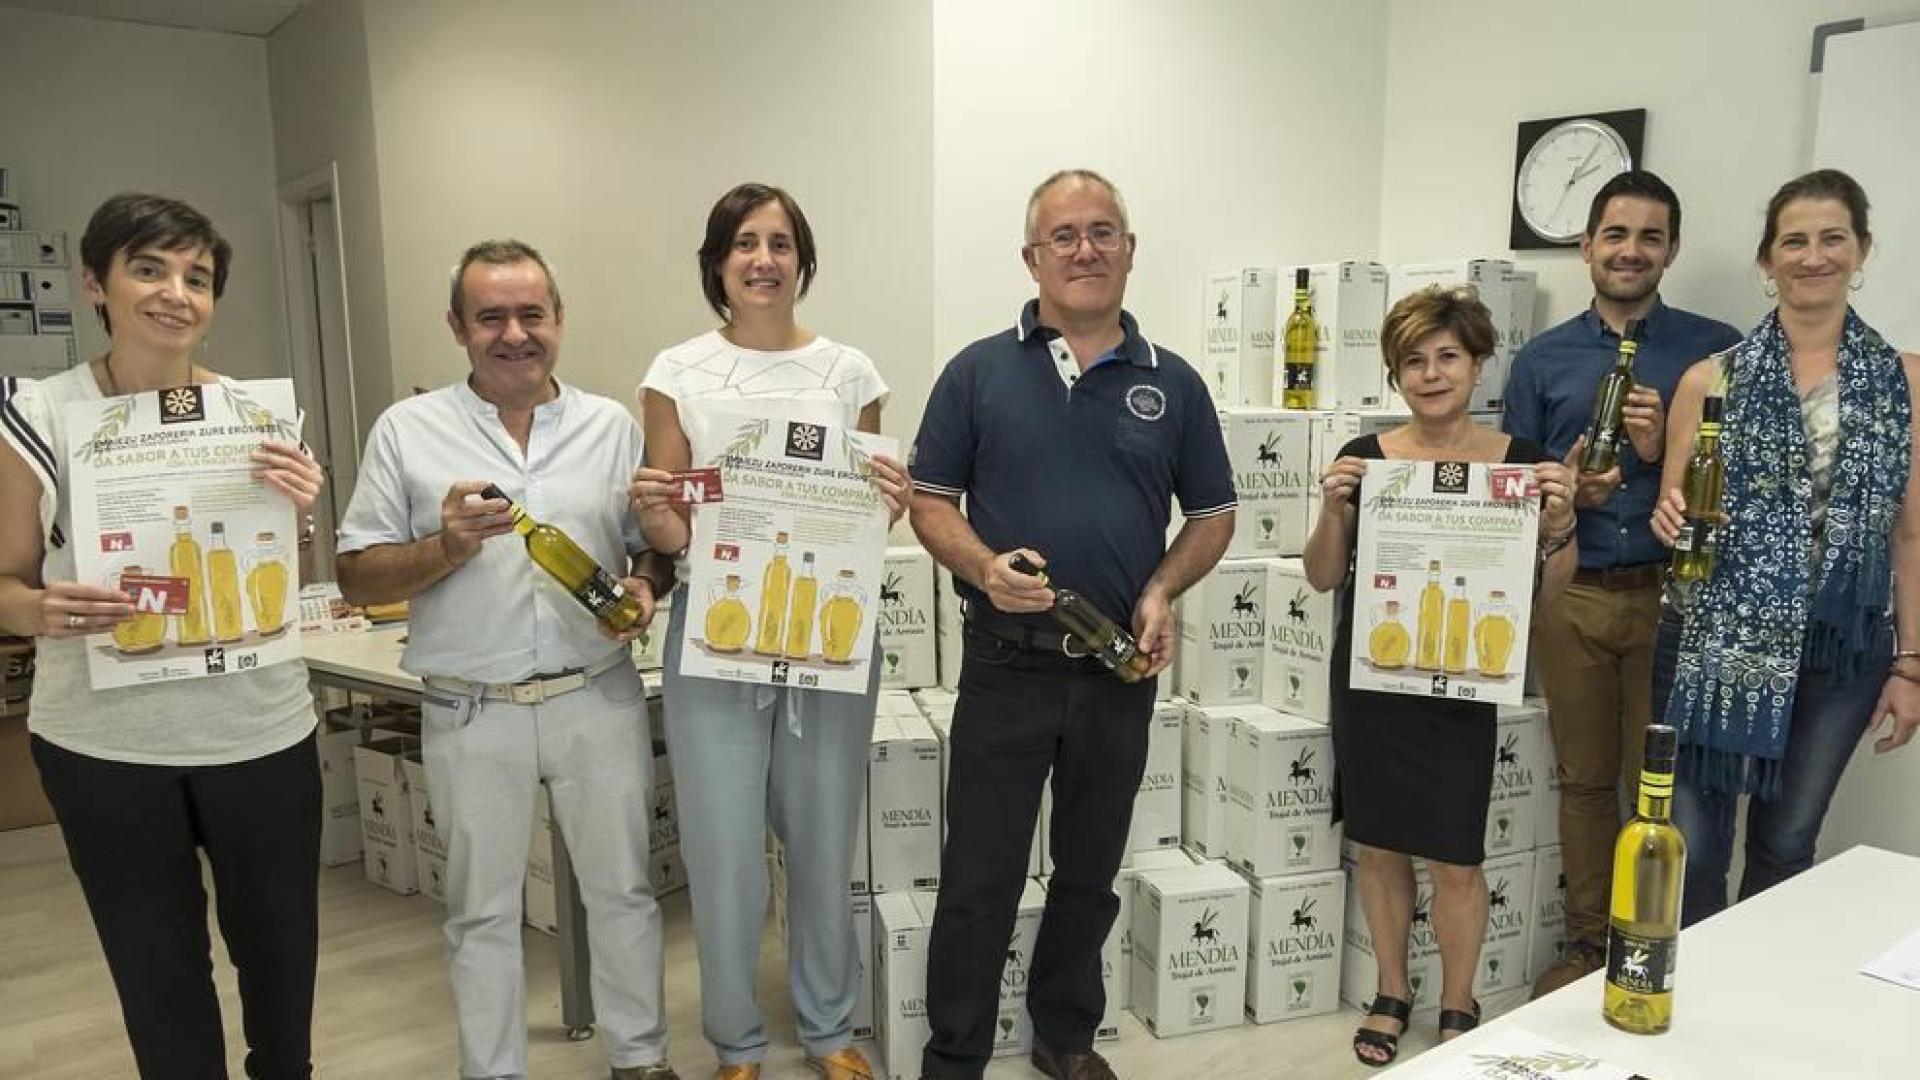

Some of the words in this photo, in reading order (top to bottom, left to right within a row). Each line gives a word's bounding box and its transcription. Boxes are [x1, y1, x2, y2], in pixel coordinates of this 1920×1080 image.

[117, 450, 167, 466] SABOR
[682, 480, 705, 503] N
[1505, 476, 1525, 497] N
[137, 587, 167, 613] N
[881, 606, 926, 626] NDÍA
[1210, 618, 1266, 640] MENDÍ
[1497, 767, 1533, 789] NDÍA
[1490, 910, 1524, 930] NDÍA
[1268, 931, 1336, 955] MENDÍA
[1168, 945, 1240, 970] MENDÍA
